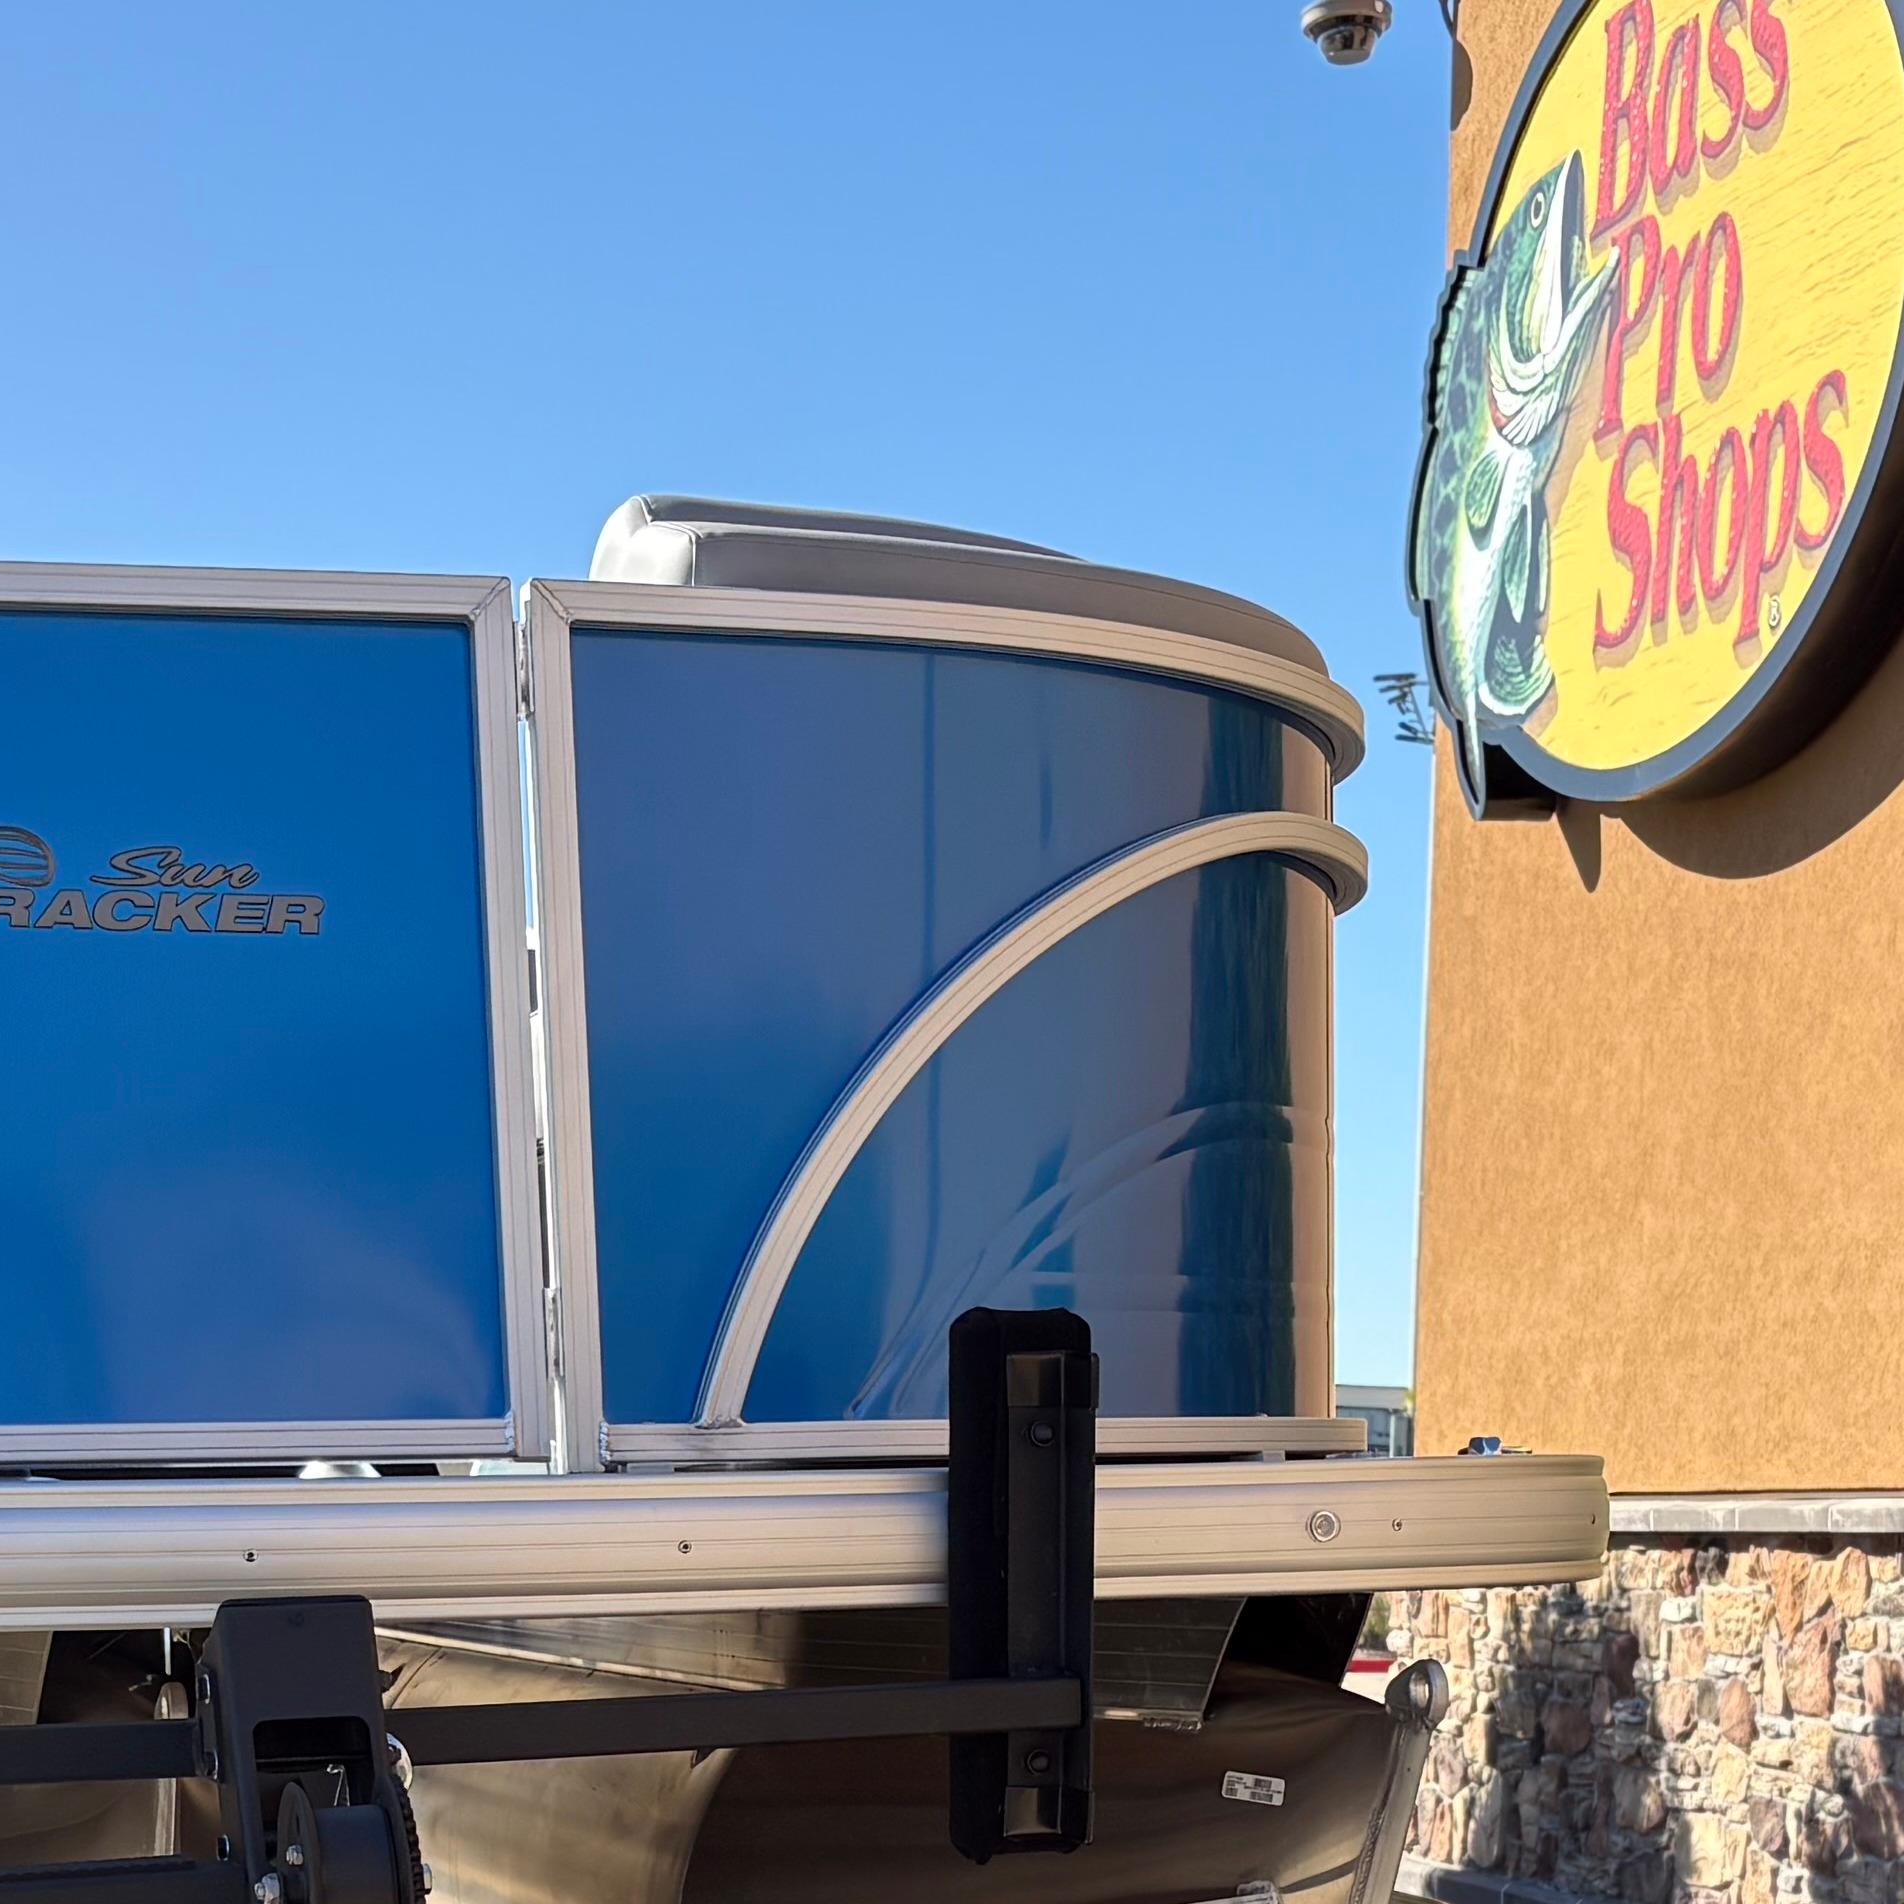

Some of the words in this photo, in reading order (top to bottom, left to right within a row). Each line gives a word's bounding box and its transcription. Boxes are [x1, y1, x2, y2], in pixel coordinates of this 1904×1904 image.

[1591, 0, 1789, 241] Bass
[1593, 211, 1743, 441] Pro
[1593, 370, 1851, 650] Shops
[89, 846, 260, 889] Sun
